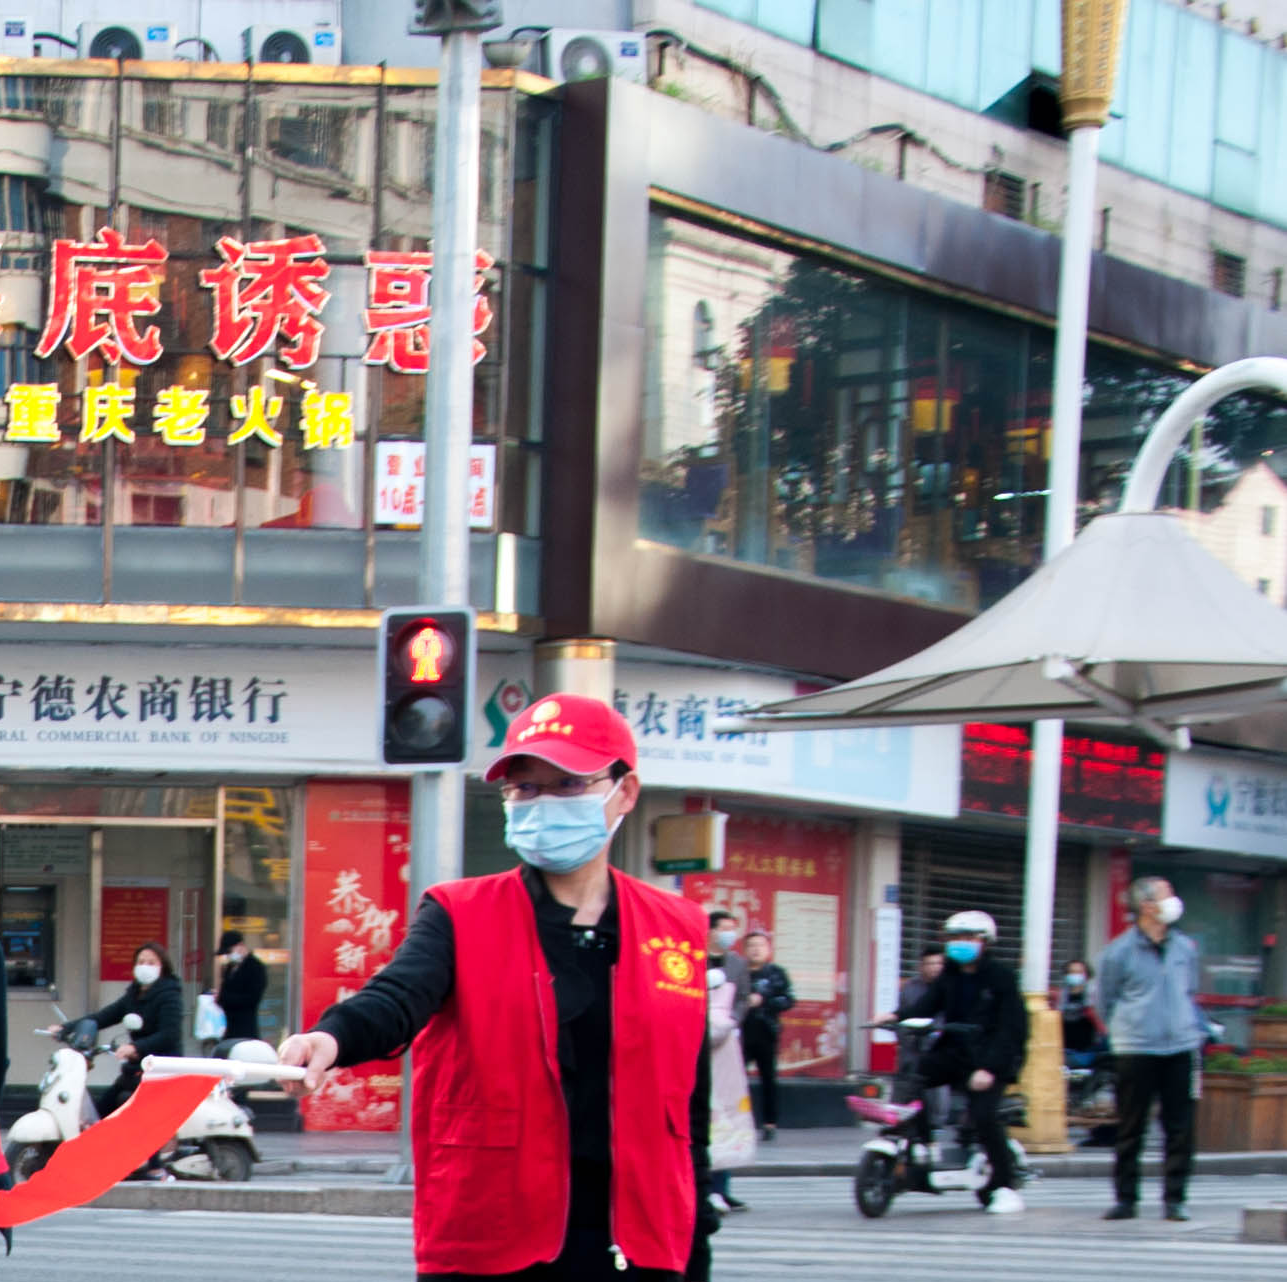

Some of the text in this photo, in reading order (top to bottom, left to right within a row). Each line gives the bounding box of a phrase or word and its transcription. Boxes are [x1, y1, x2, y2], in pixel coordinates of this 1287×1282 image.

[4, 380, 357, 450] 重庆老火锅
[36, 730, 140, 744] COMMERCIAL
[150, 731, 191, 744] BANK
[200, 731, 220, 744] OF
[228, 731, 290, 744] NINGDE
